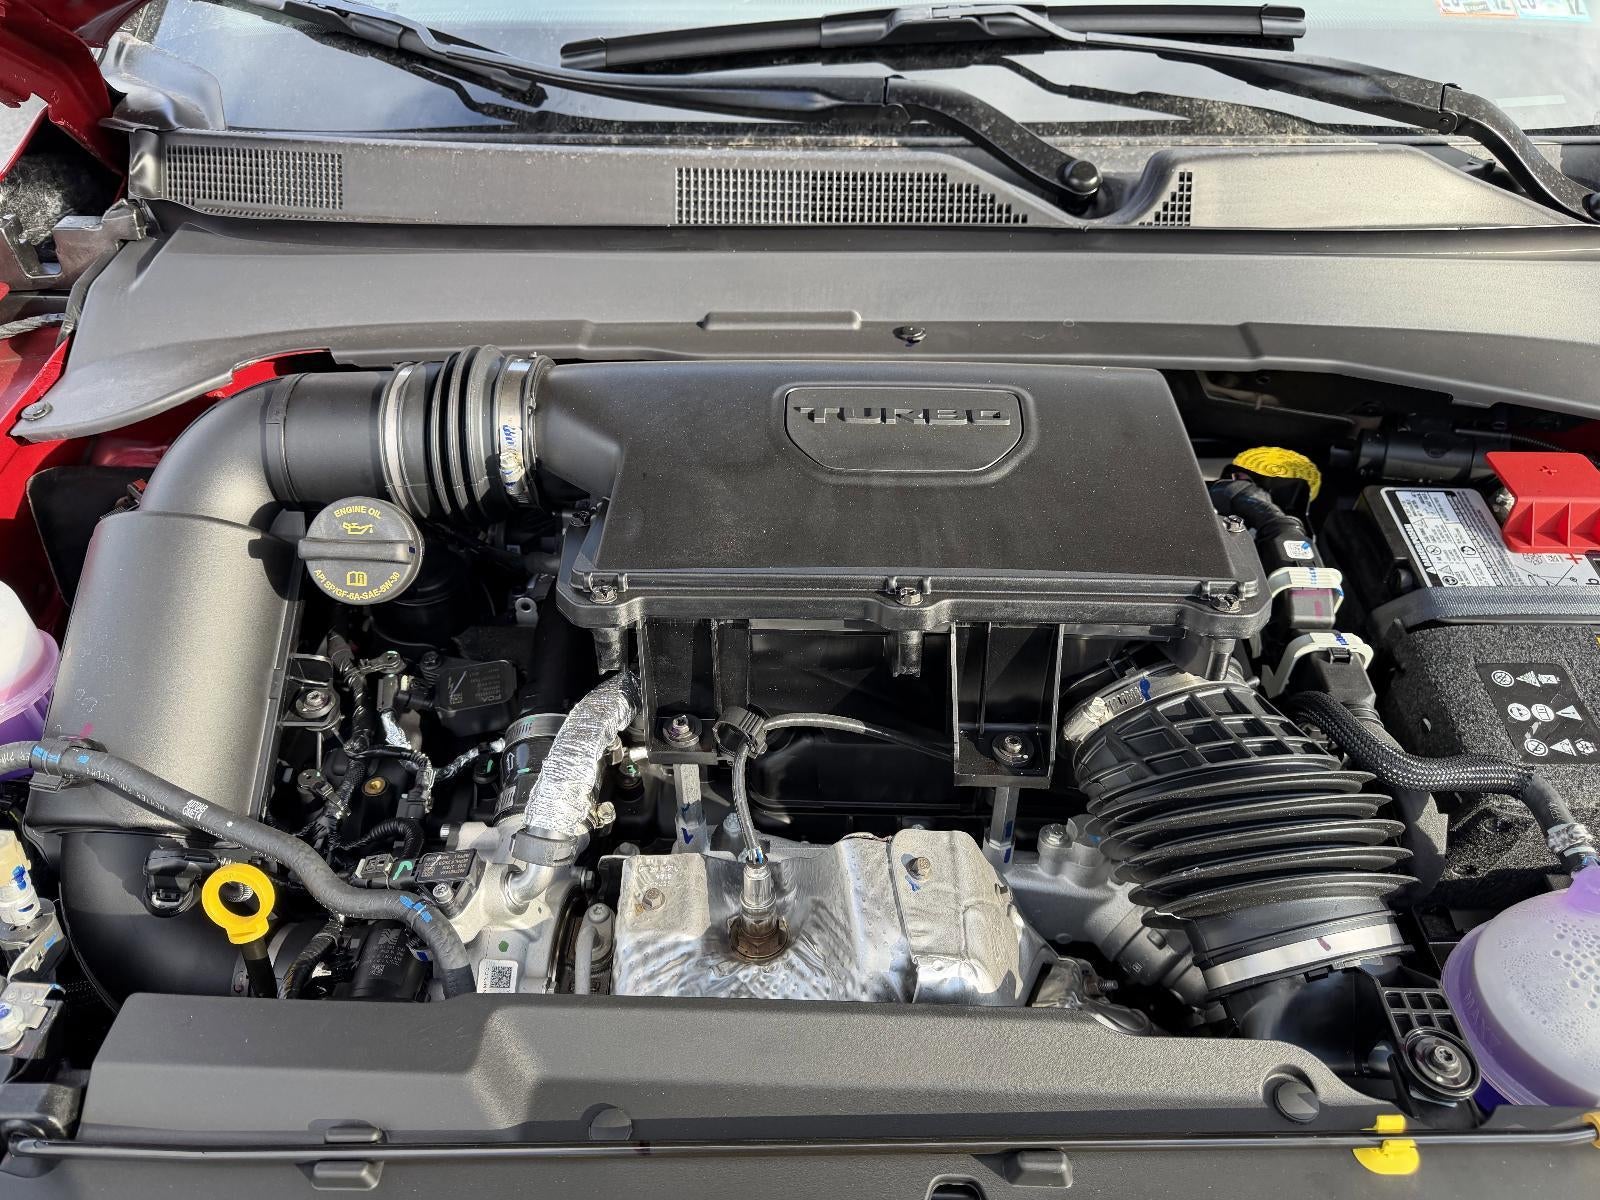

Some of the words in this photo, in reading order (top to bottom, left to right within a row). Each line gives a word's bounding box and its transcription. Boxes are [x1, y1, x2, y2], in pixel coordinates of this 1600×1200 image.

[793, 406, 1011, 426] TURBO
[335, 506, 367, 518] ENGINE
[368, 507, 383, 519] OIL
[314, 569, 326, 584] API
